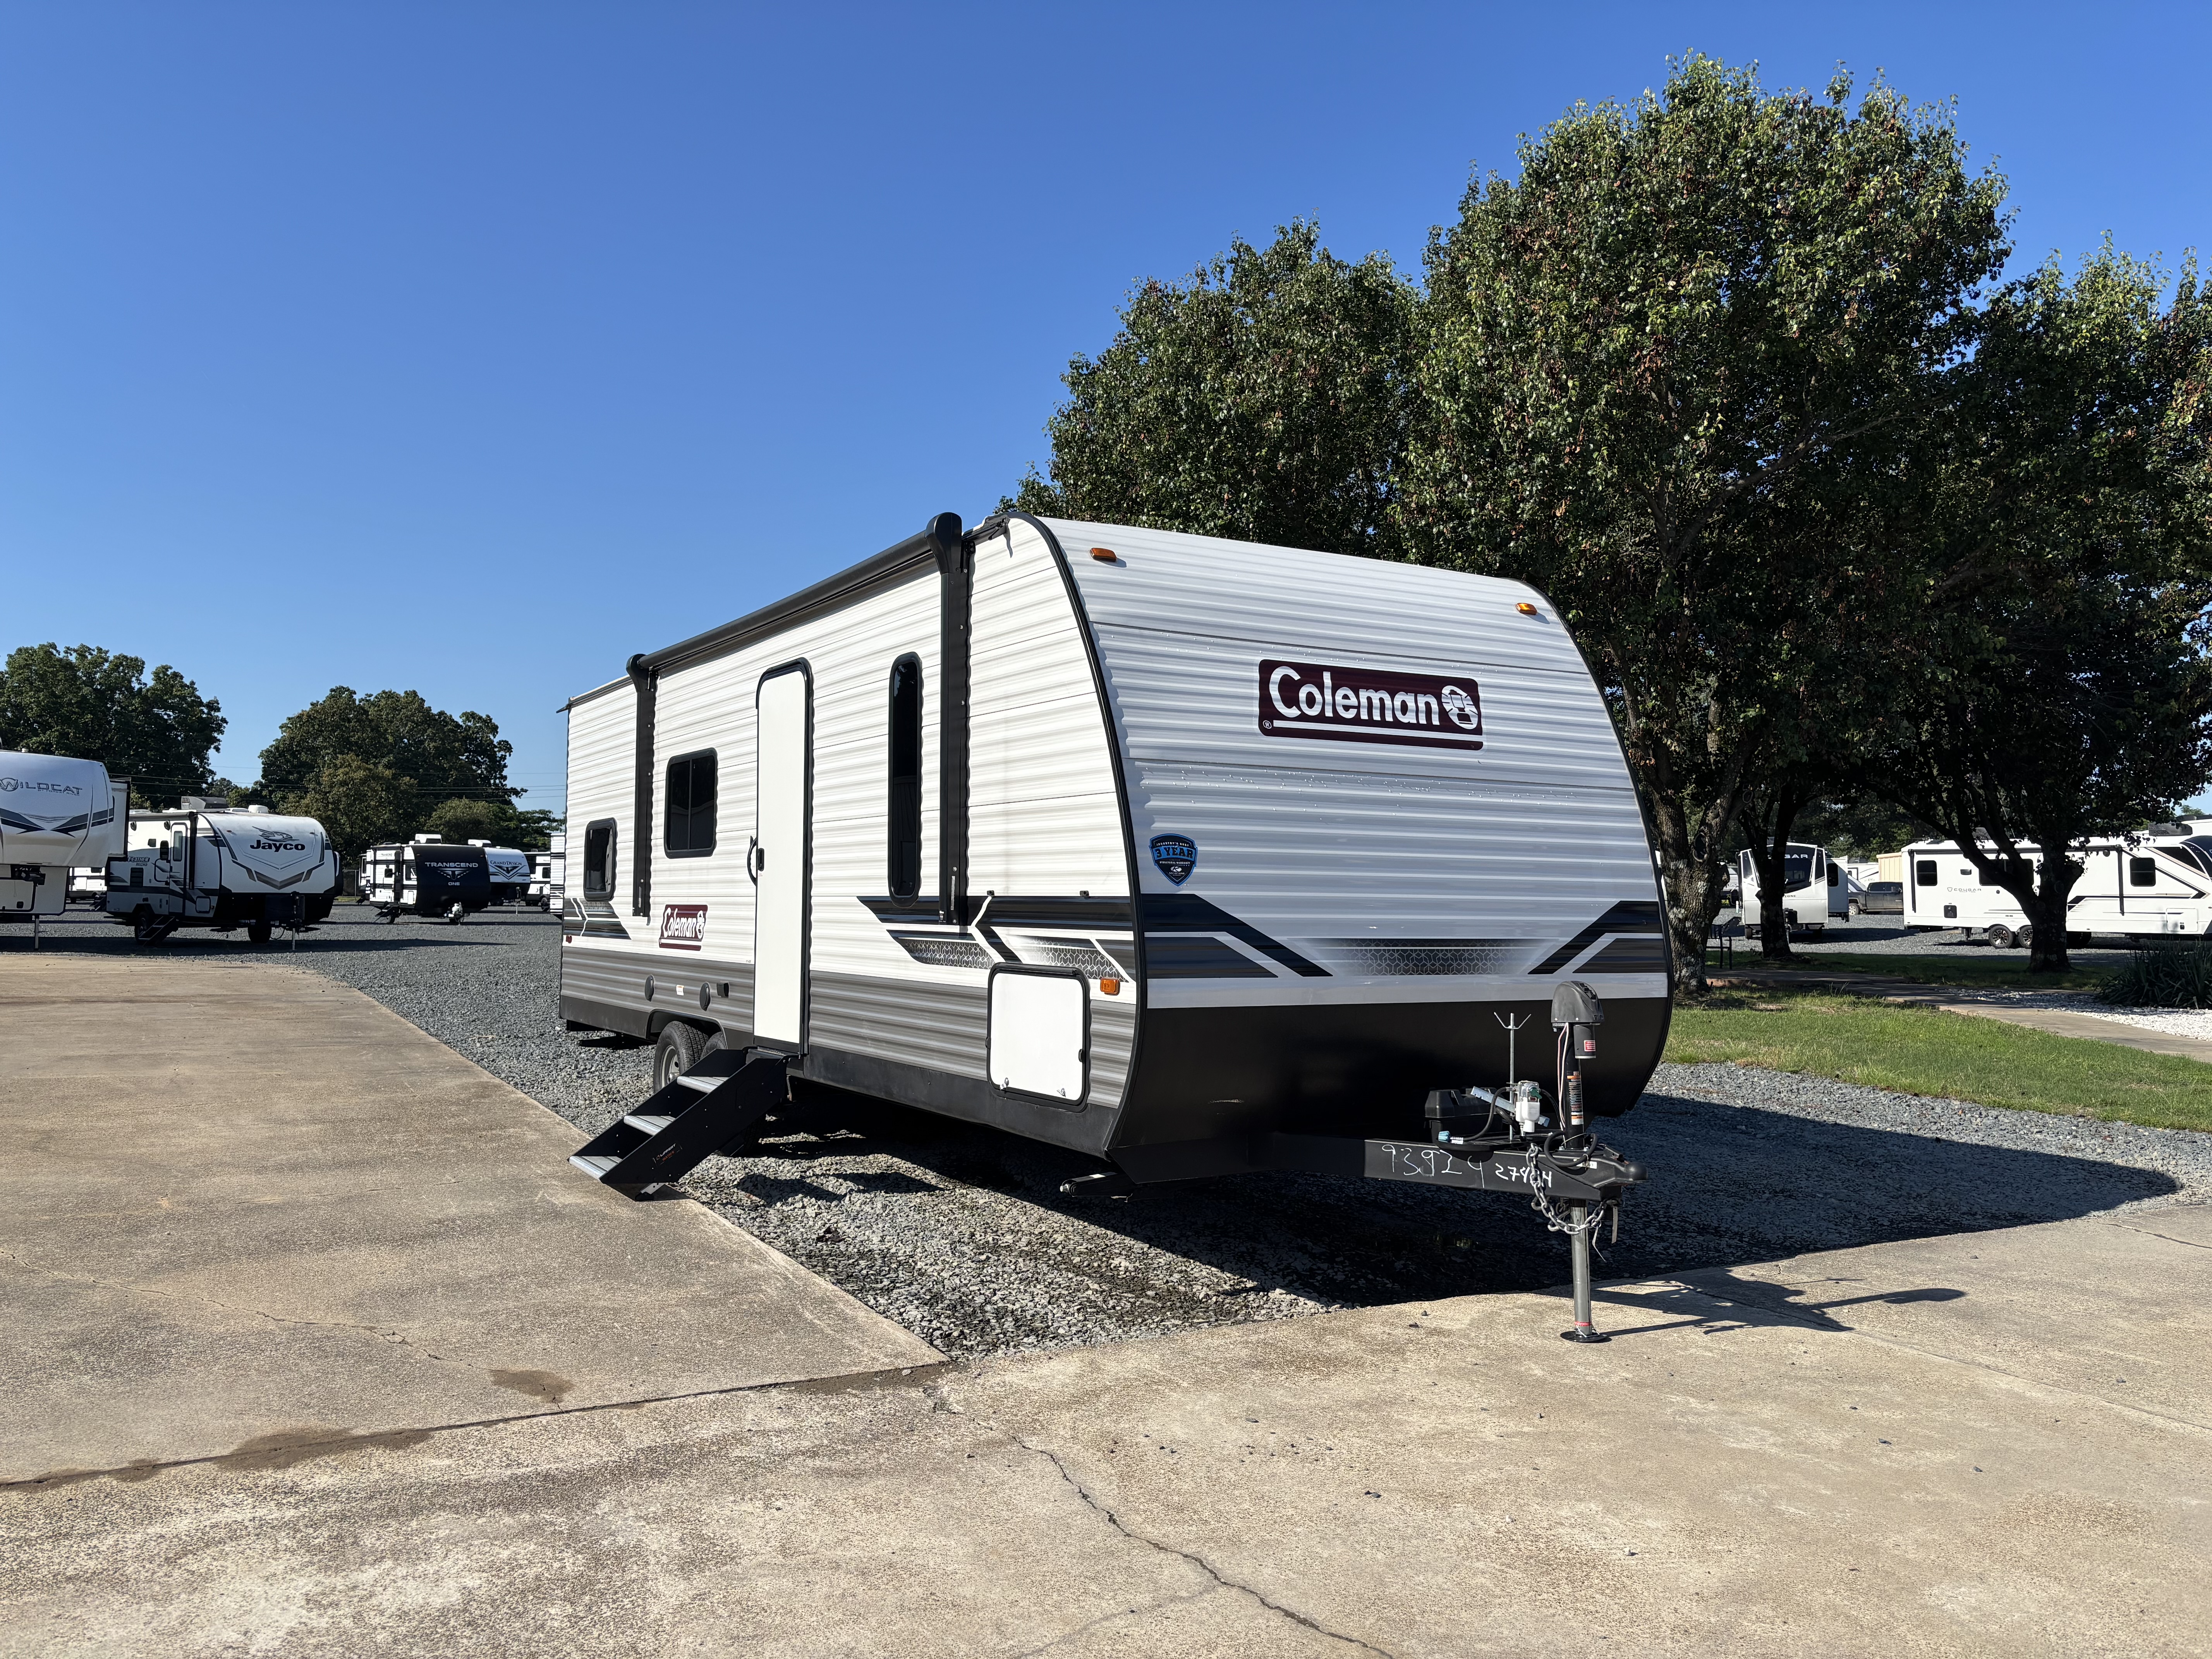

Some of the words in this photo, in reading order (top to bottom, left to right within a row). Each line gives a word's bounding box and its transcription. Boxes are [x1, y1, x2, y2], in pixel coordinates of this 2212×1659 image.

[1269, 666, 1440, 725] Coleman
[0, 778, 82, 794] WILDCAT
[250, 840, 306, 852] Jayco
[1155, 848, 1162, 858] 3
[1164, 847, 1193, 859] YEAR
[663, 907, 697, 938] Coleman
